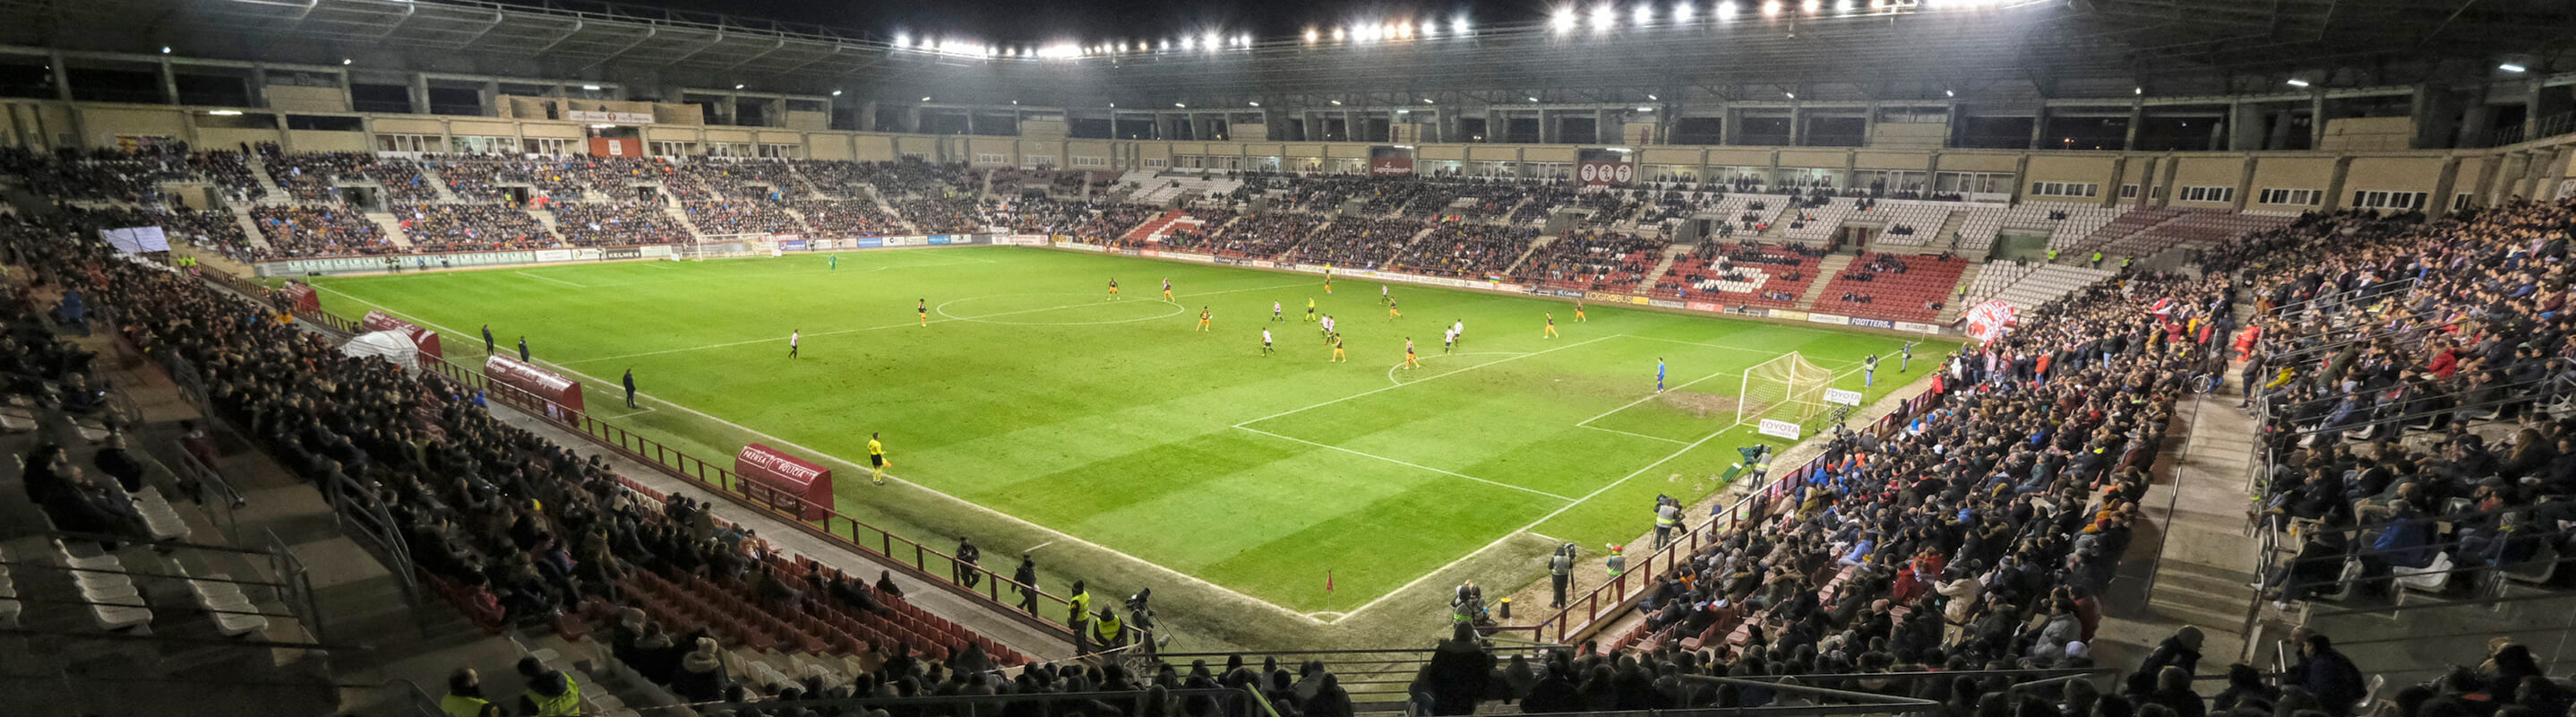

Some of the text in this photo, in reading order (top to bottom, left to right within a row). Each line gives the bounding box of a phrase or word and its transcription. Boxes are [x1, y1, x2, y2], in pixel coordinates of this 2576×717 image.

[1585, 292, 1633, 303] LOGROBUS
[1827, 389, 1860, 401] TOYOTA
[1761, 420, 1799, 434] TOYOTA
